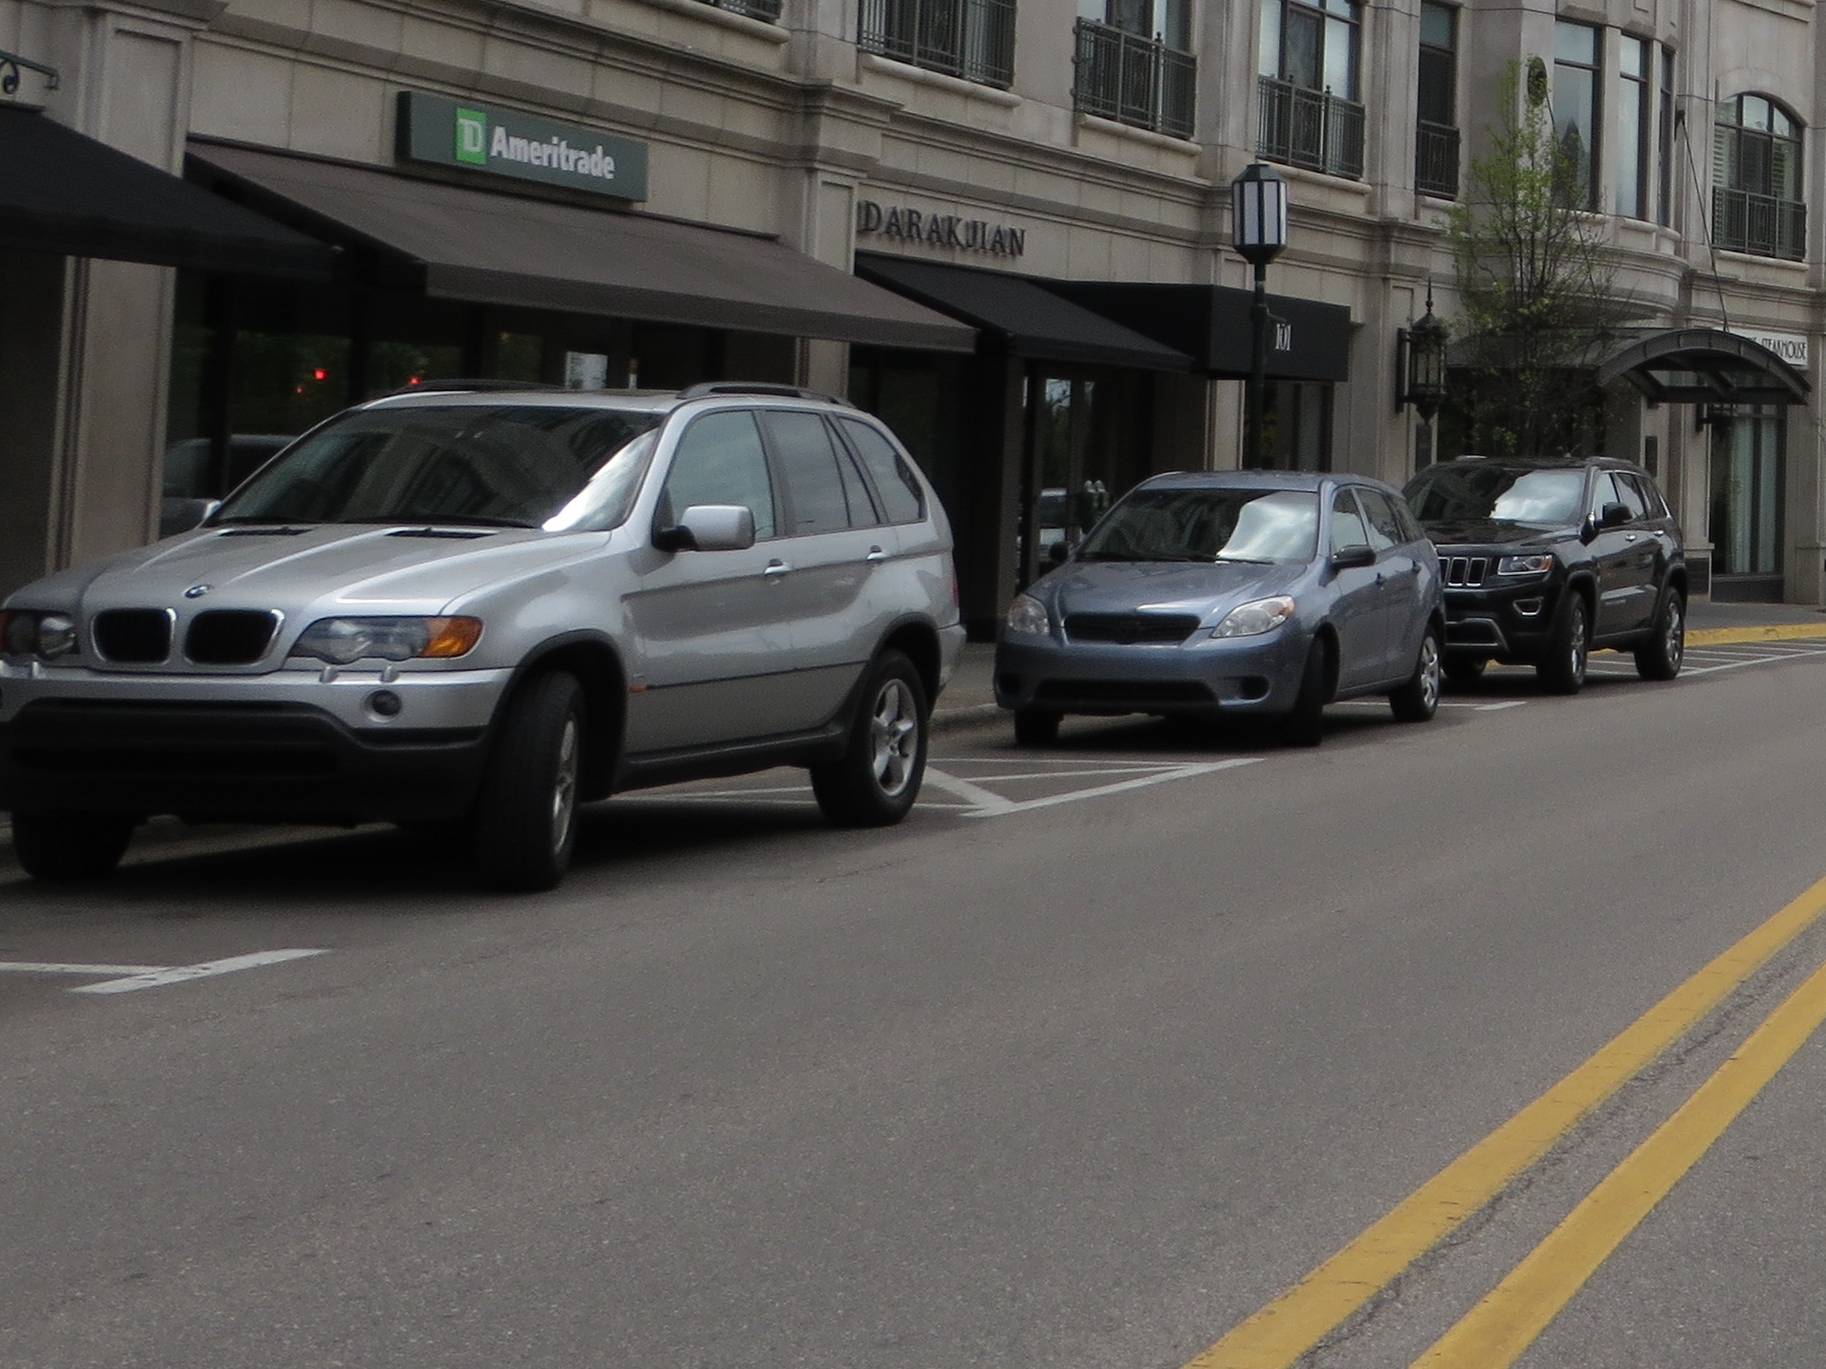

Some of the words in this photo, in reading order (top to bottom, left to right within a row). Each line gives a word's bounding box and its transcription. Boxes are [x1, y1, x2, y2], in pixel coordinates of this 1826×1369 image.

[459, 118, 483, 153] TD
[490, 125, 615, 179] Ameritrade
[857, 200, 1026, 257] DARAKJIAN
[1275, 323, 1291, 351] 101
